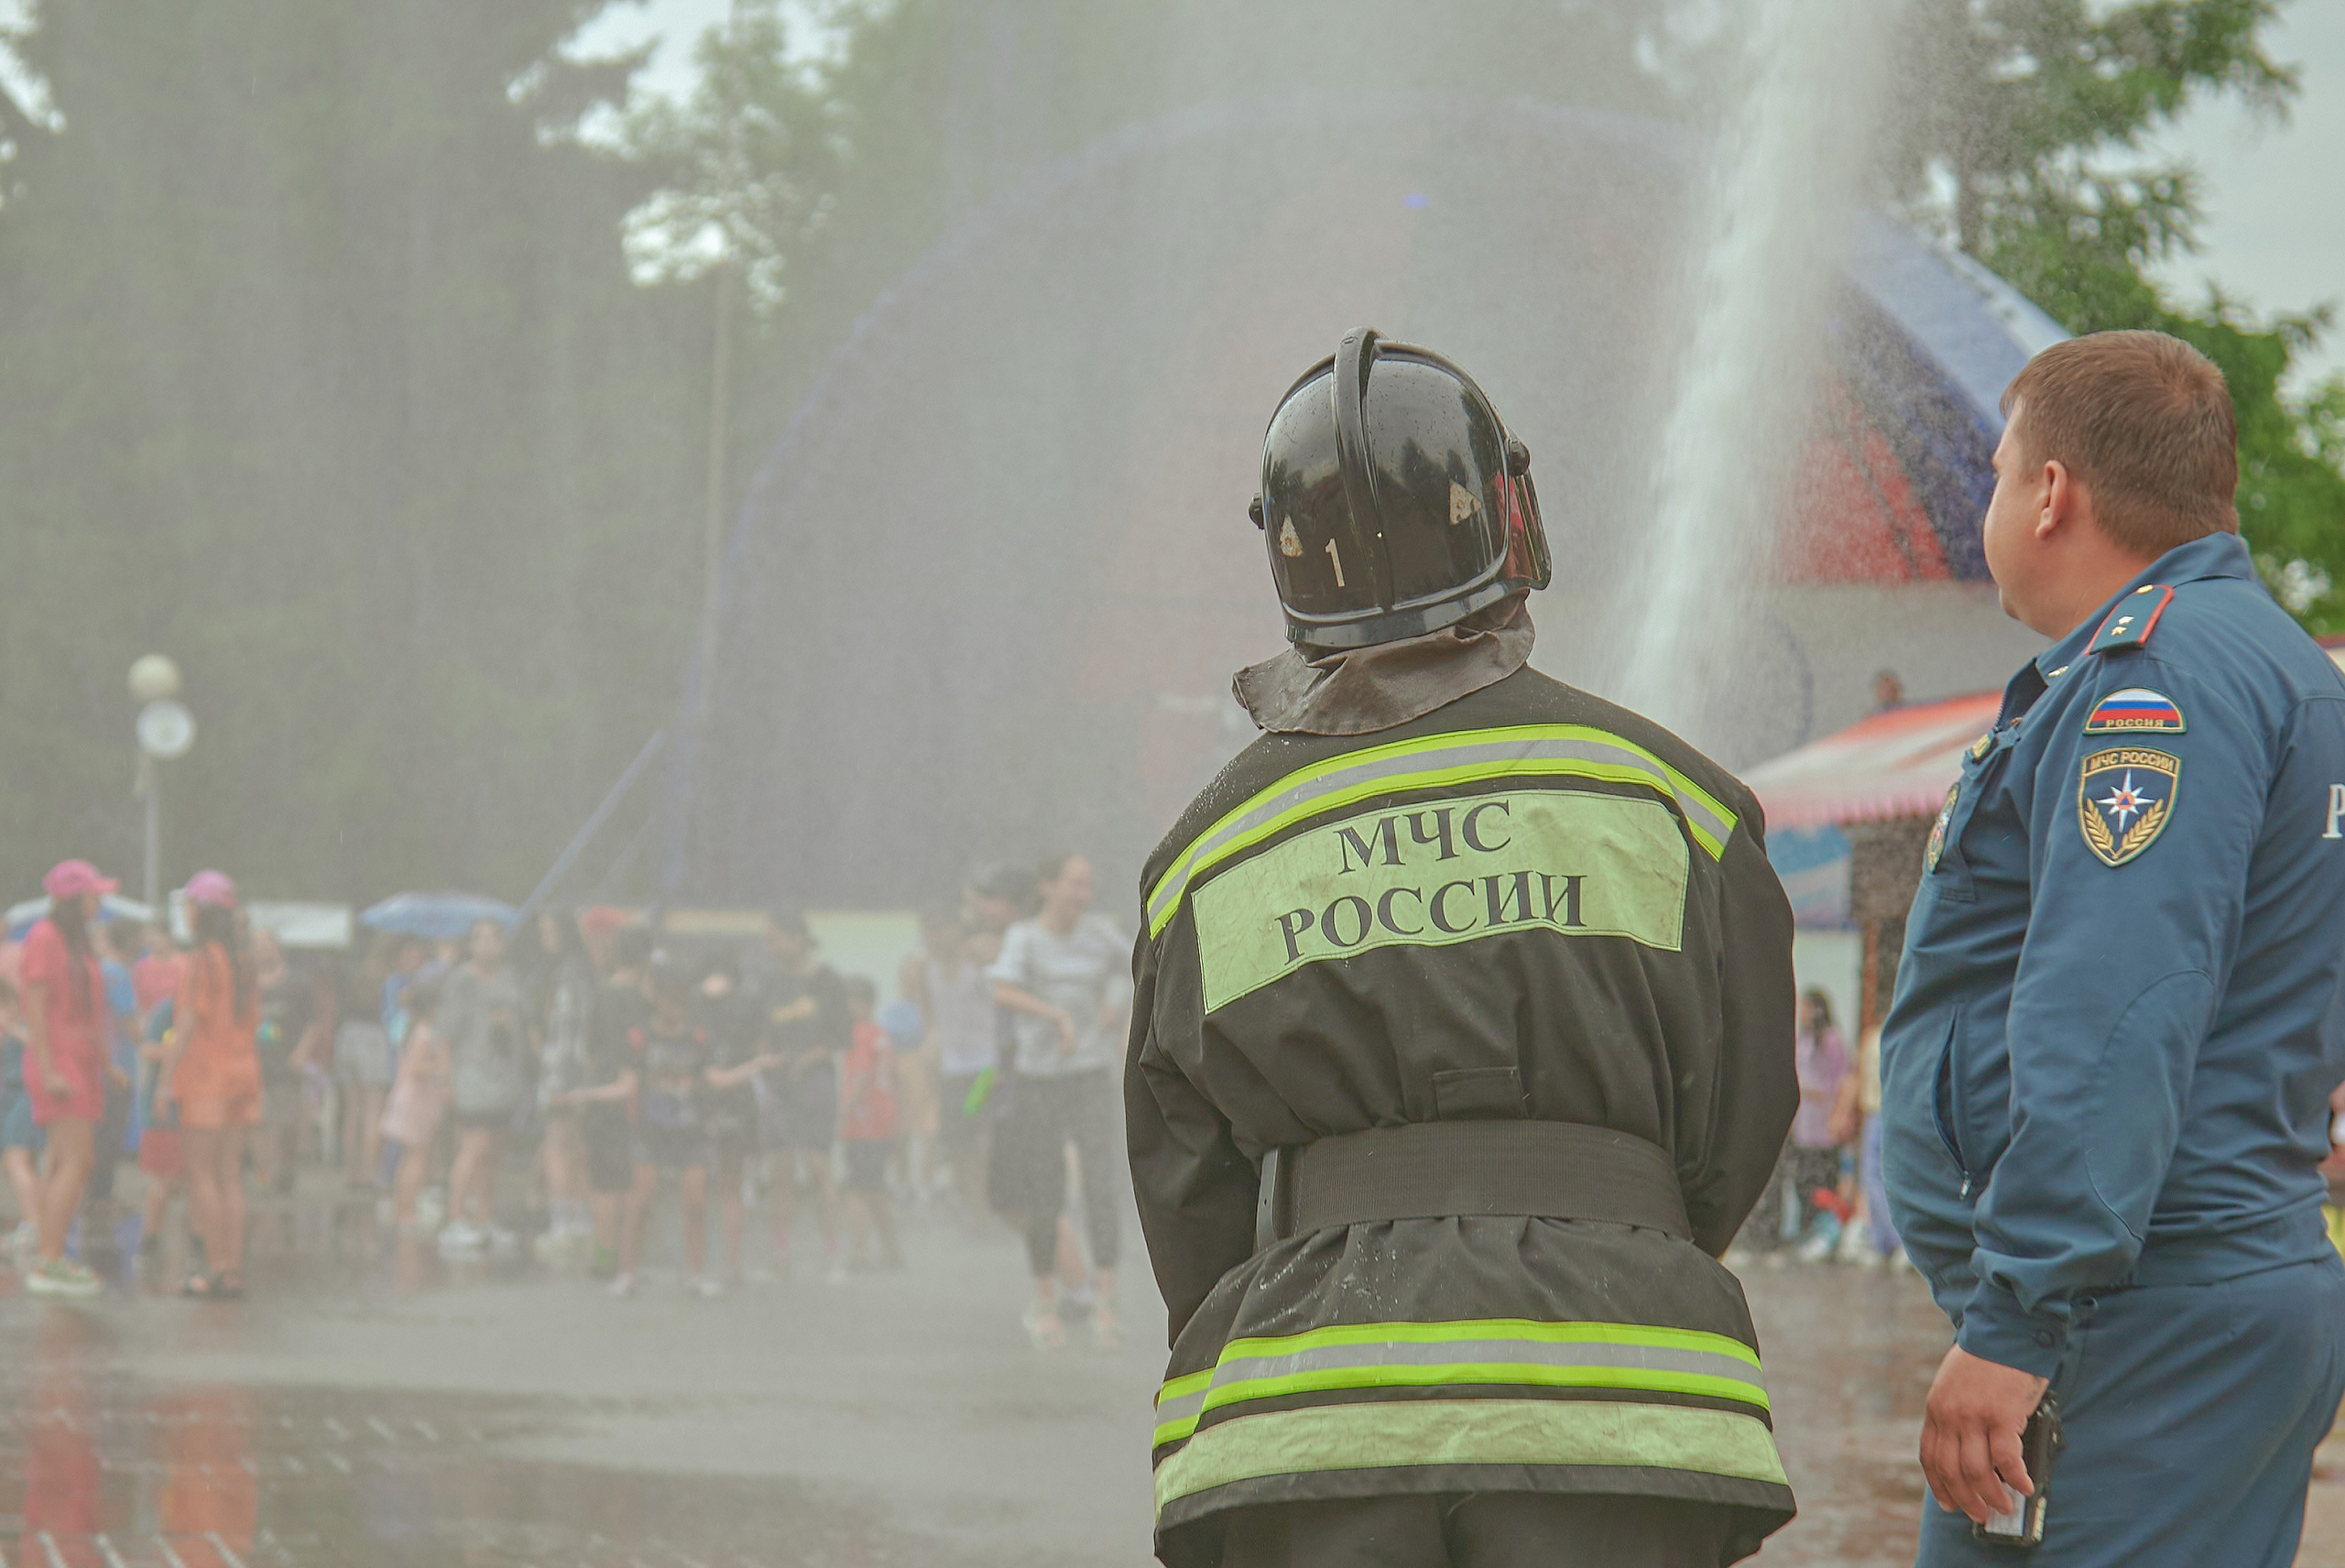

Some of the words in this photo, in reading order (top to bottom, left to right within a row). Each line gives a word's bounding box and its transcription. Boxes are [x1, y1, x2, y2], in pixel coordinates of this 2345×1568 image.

[1325, 538, 1345, 587] 1
[2106, 718, 2165, 727] РОССИЯ
[2089, 753, 2119, 770] МЧС
[2121, 751, 2175, 771] РОССИИ
[1337, 800, 1511, 875] МЧС
[1275, 870, 1587, 964] РОССИИ
